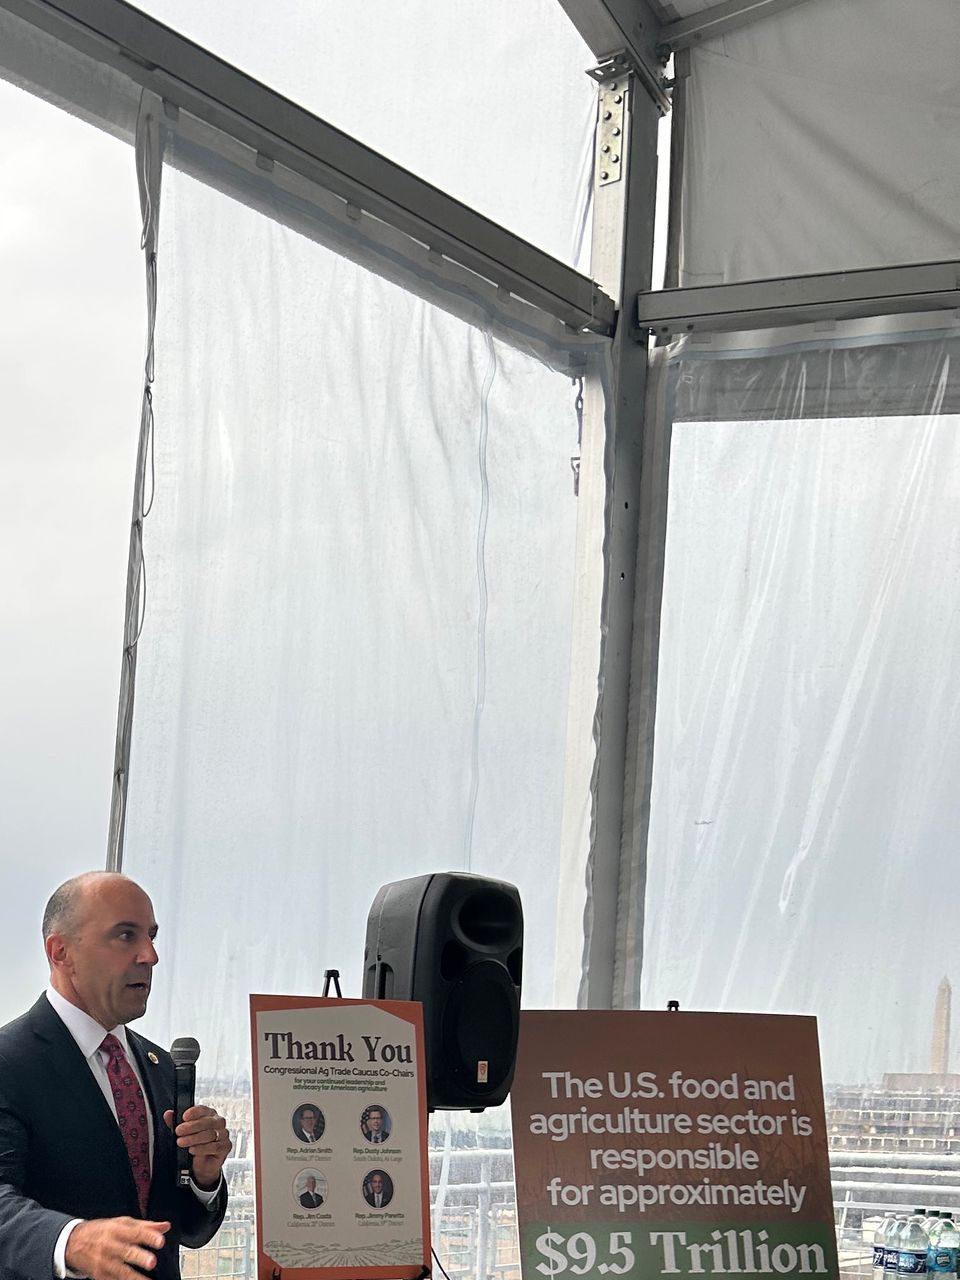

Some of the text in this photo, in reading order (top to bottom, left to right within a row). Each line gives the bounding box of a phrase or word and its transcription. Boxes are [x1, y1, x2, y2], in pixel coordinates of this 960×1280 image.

[264, 1031, 413, 1064] Thank You
[263, 1065, 415, 1078] Congressional Ag Trade Caucus Co-Chairs
[542, 1070, 796, 1101] The U.S. food and
[529, 1106, 813, 1142] agriculture sector is
[590, 1143, 760, 1177] responsible
[546, 1177, 807, 1213] for approximately
[535, 1226, 829, 1280] $9.5 Trillion
